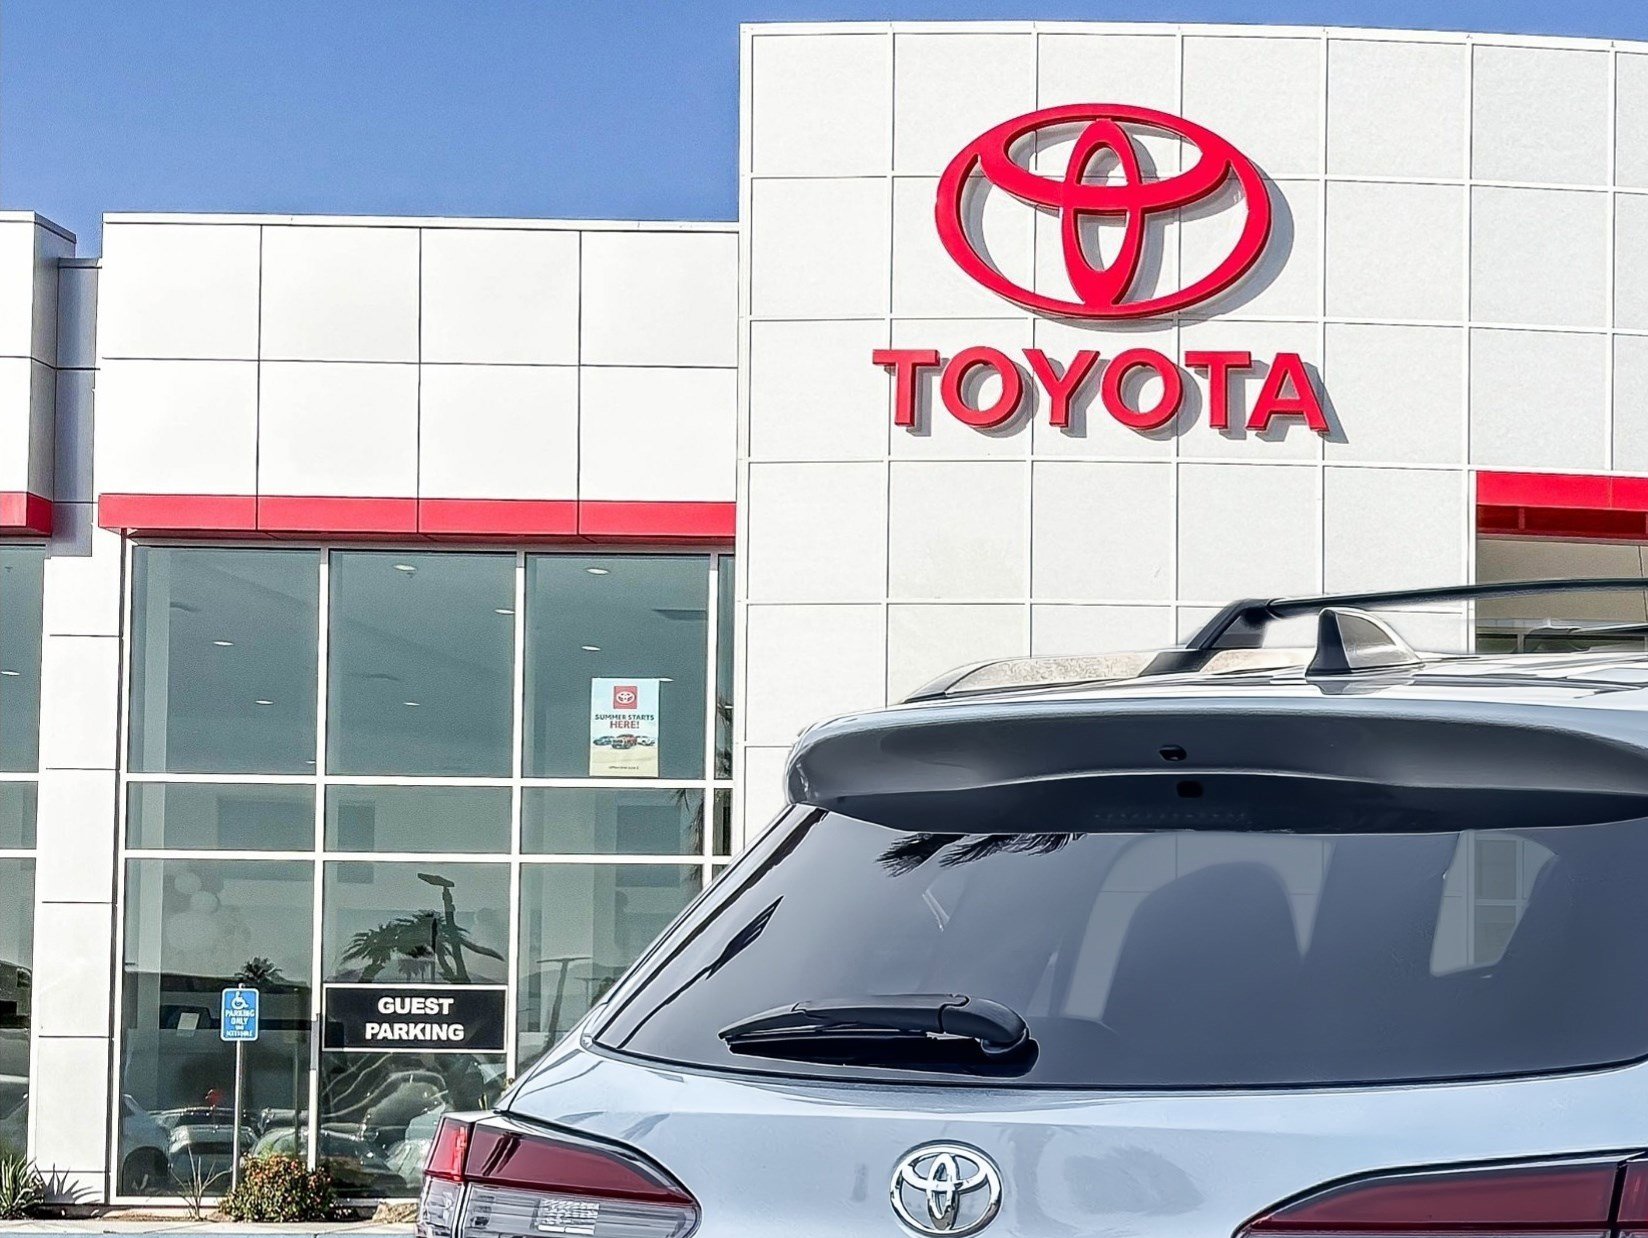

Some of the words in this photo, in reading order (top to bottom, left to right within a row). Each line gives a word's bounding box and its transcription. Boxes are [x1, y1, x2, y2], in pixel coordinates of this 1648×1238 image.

[872, 346, 1330, 434] TOYOTA
[609, 720, 640, 729] HERE!
[377, 996, 454, 1015] GUEST
[364, 1022, 465, 1041] PARKING
